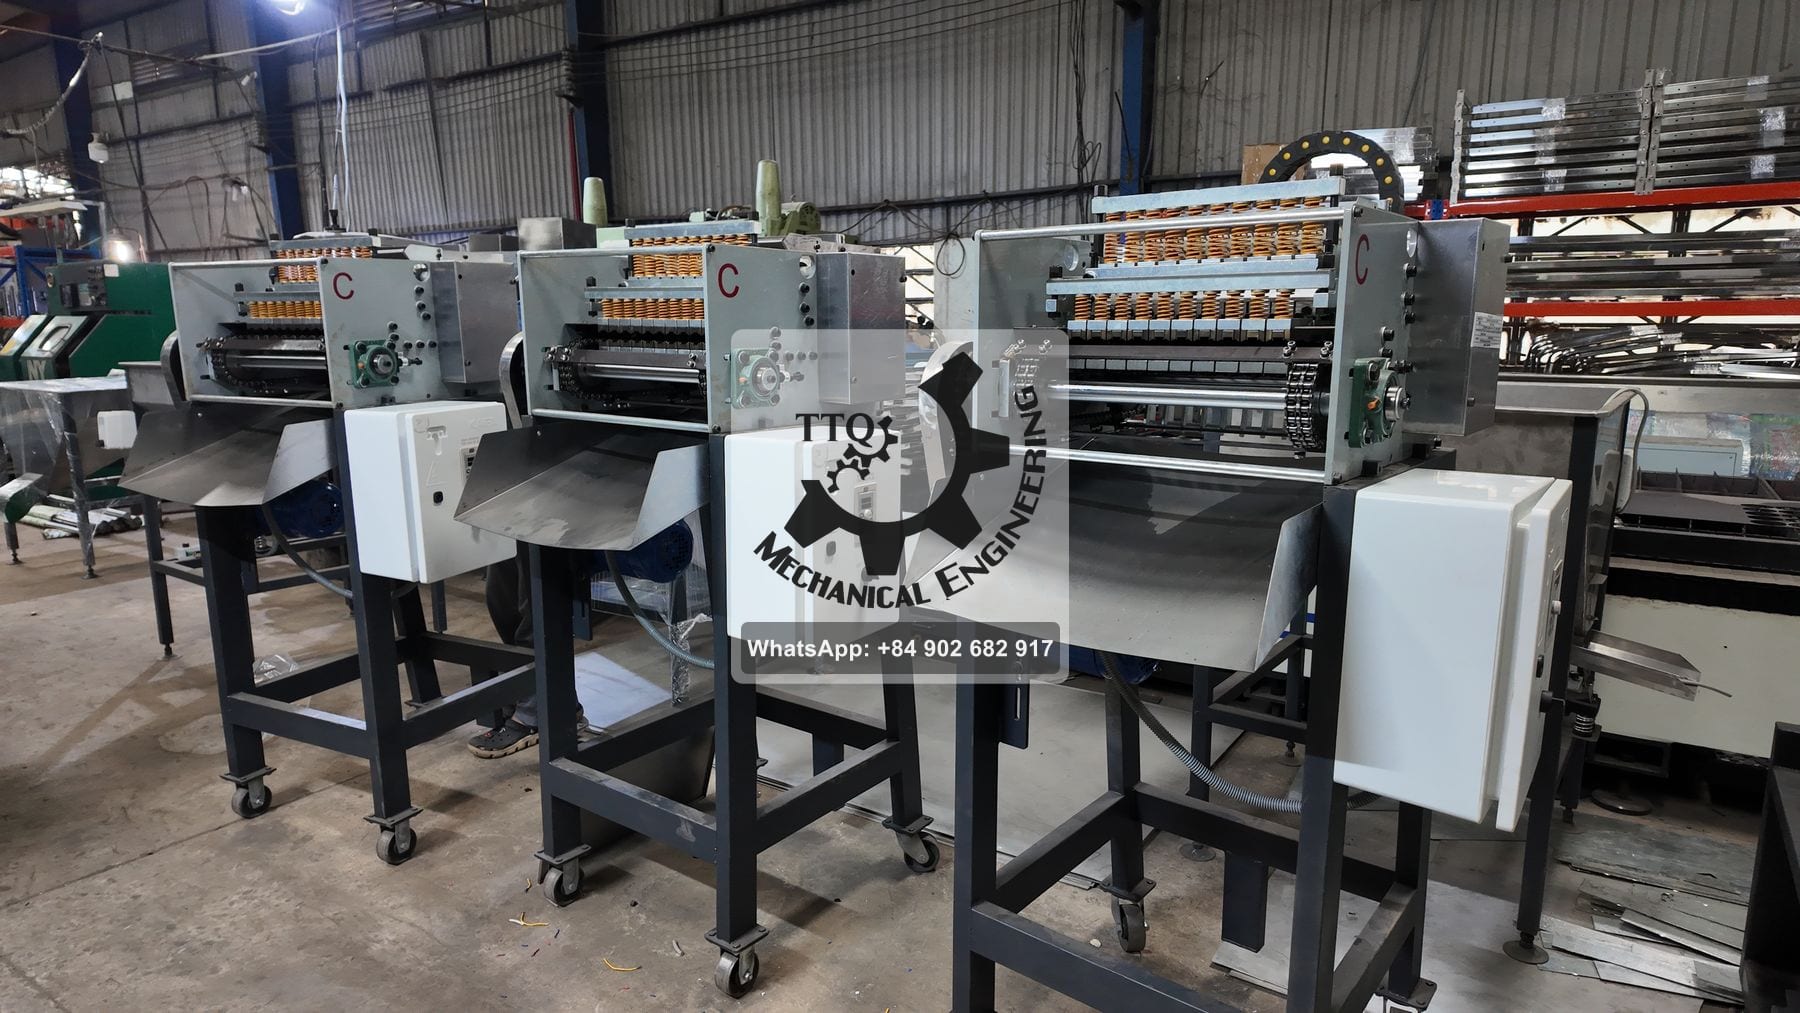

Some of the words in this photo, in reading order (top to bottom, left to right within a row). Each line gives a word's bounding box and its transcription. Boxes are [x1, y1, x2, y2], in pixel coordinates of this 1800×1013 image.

[1356, 234, 1370, 284] C
[333, 272, 354, 299] C
[718, 263, 739, 298] C
